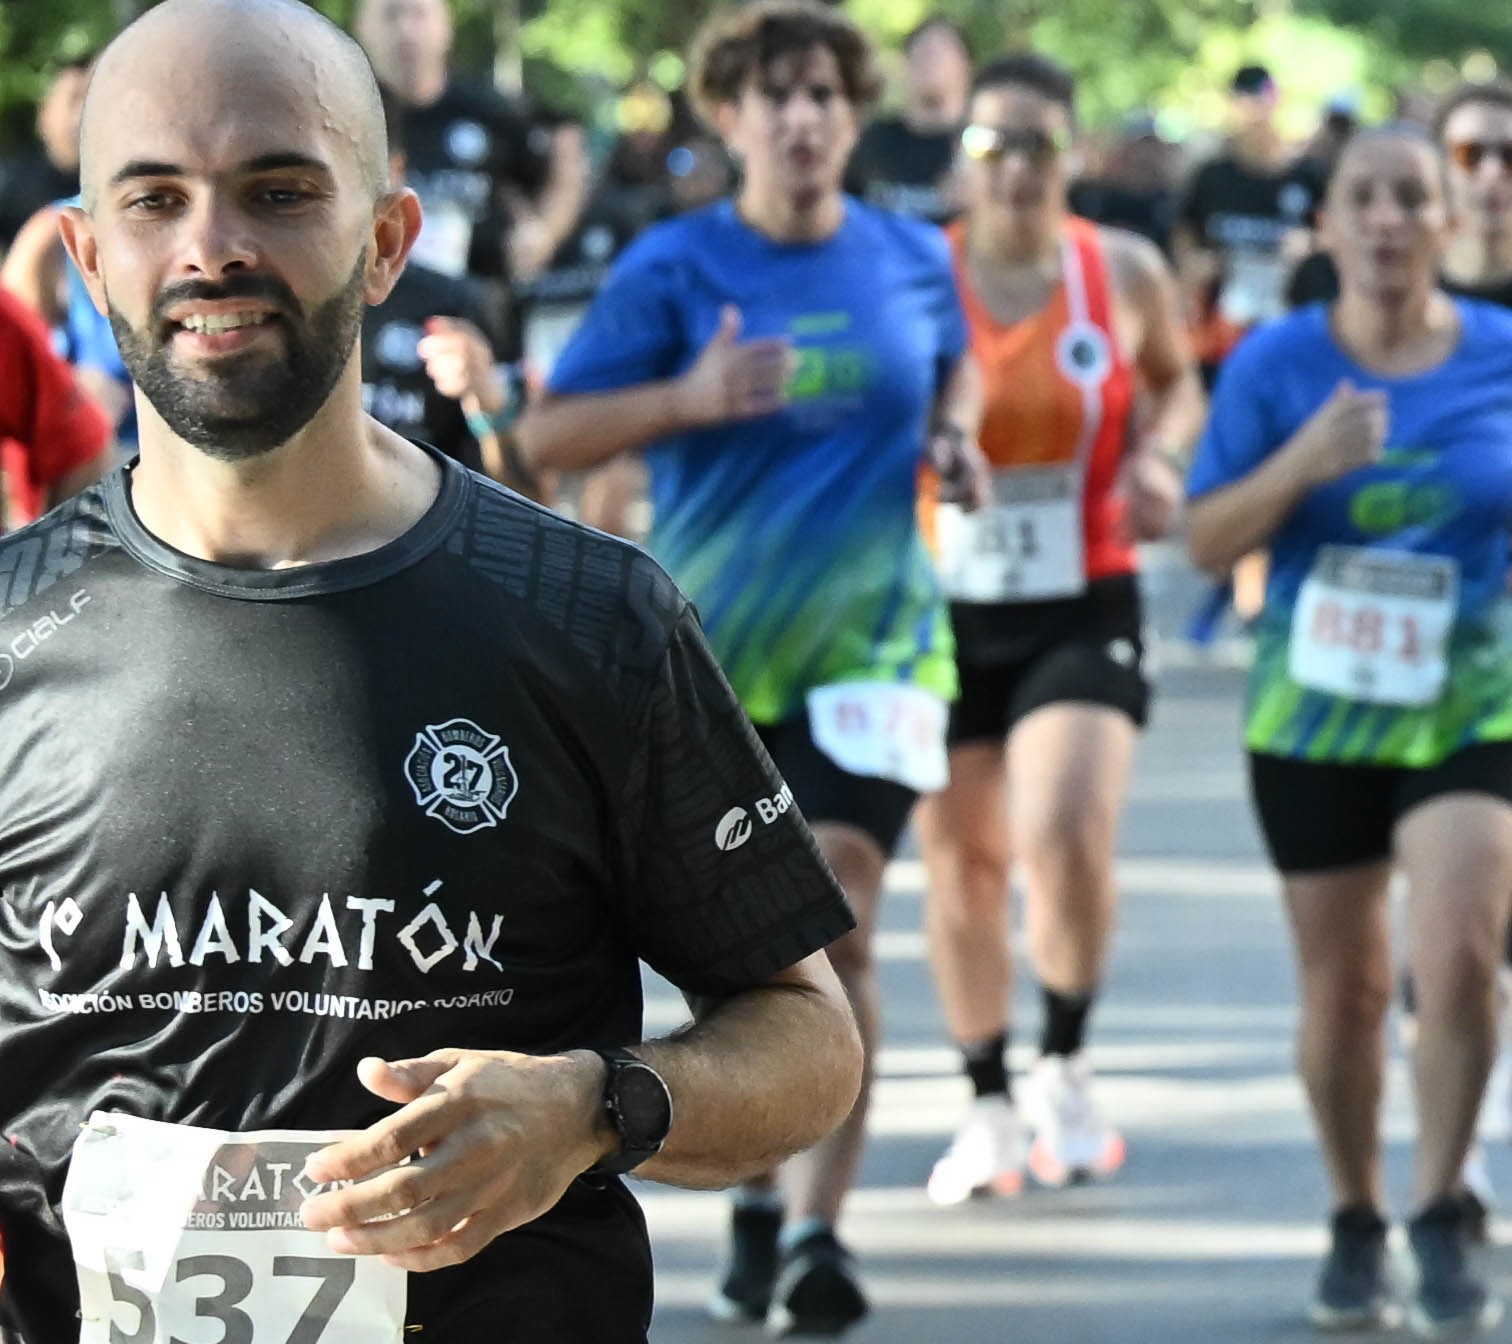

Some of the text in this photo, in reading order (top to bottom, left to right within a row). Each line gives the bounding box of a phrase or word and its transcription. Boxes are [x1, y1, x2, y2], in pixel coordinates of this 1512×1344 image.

[443, 752, 485, 791] 27
[119, 878, 504, 974] MARATÓN
[187, 1211, 306, 1229] EROS VOLUNTAR
